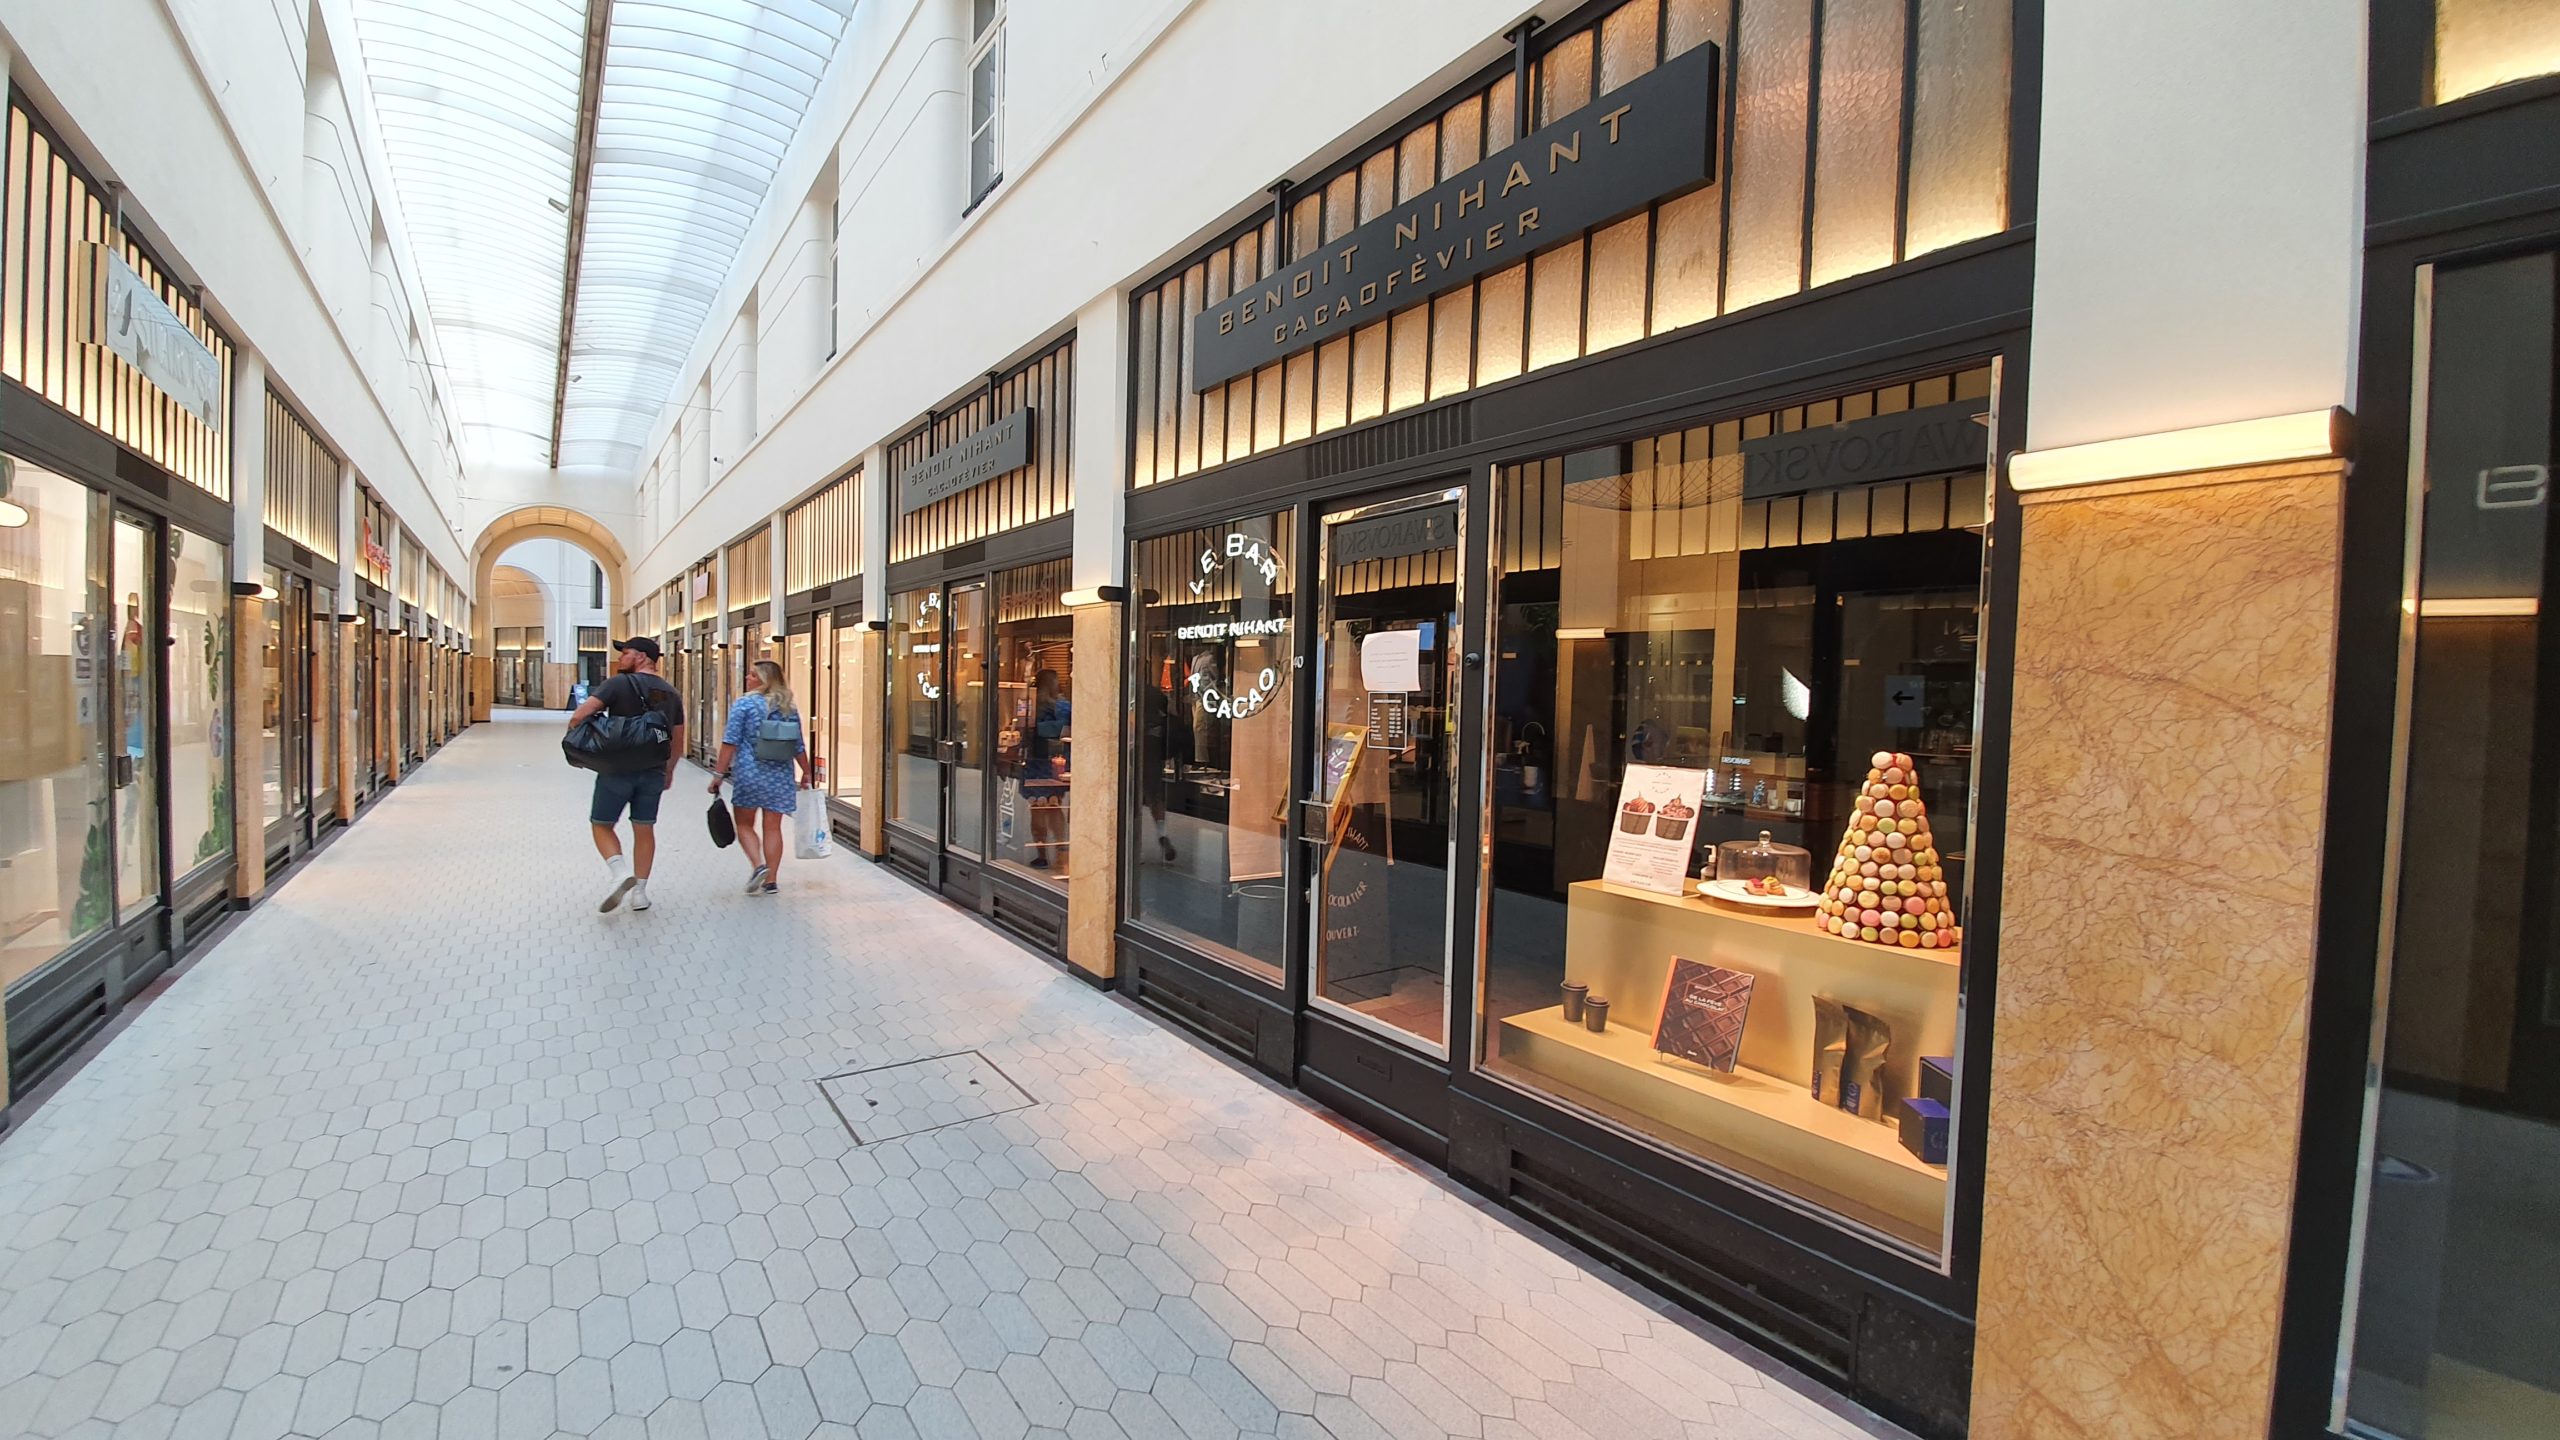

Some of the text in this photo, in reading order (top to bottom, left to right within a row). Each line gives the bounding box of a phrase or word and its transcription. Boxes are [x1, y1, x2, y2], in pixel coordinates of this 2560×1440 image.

[1219, 103, 1632, 336] BENOIT NIHANT
[1273, 206, 1541, 345] CACAOFÈVIER
[911, 423, 1014, 487] BENOIT NIHANT
[1188, 533, 1278, 596] LE BAR
[1177, 617, 1287, 640] BENOIT NIHANT
[1202, 667, 1275, 719] CACAO
[1328, 880, 1368, 907] OCOLATIER
